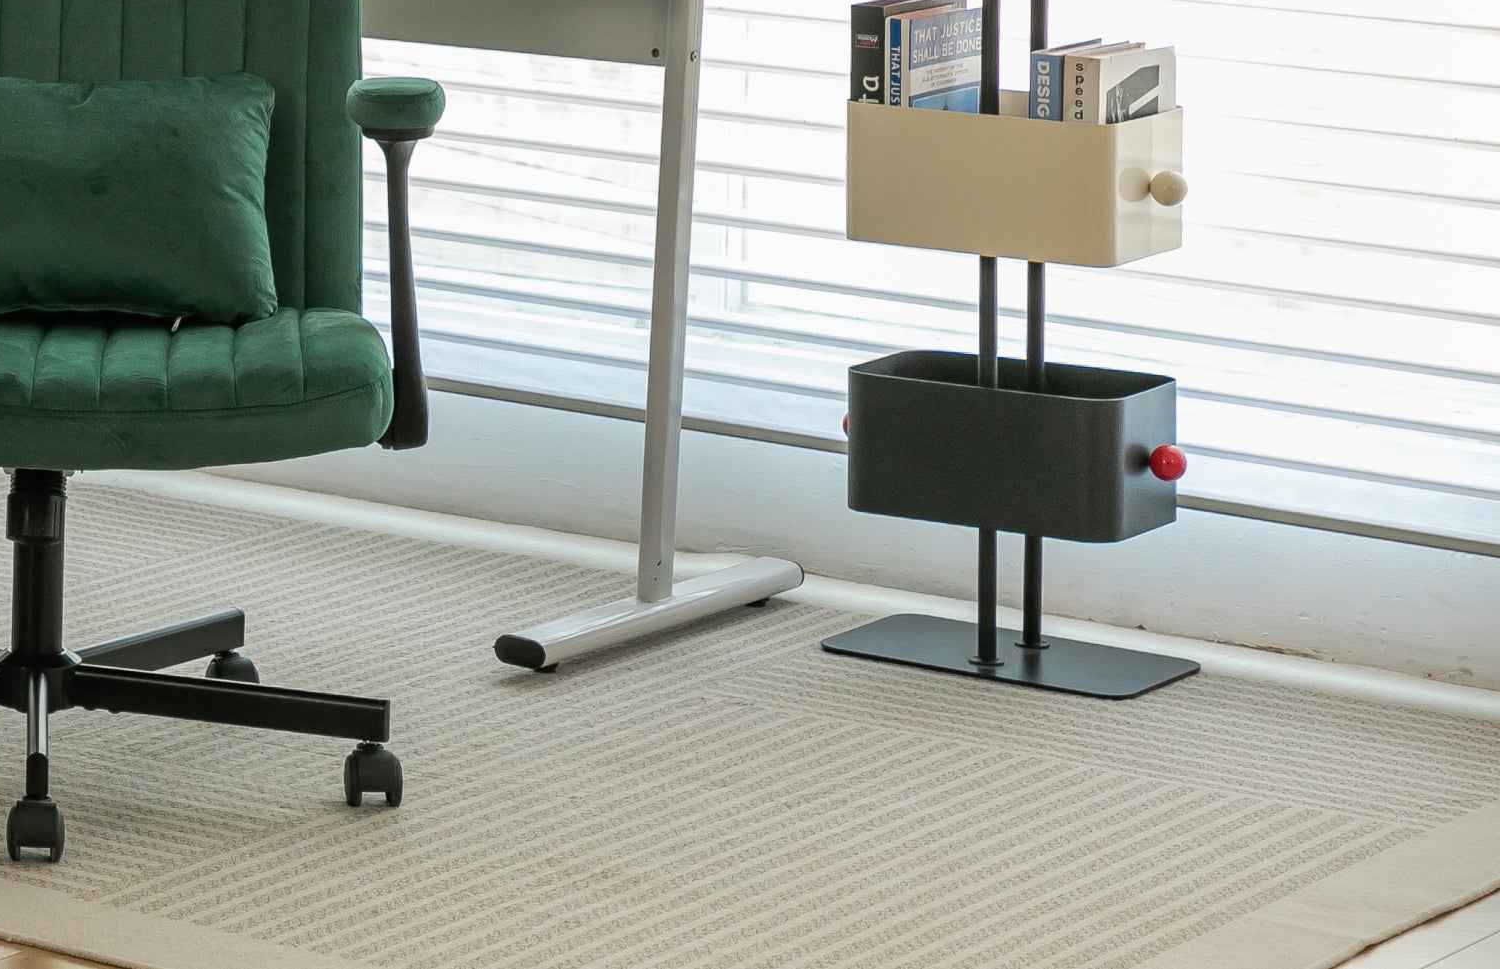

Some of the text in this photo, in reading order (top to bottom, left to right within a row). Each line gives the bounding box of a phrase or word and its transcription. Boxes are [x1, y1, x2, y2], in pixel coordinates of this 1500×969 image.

[914, 17, 981, 43] THAT JUSTICE
[890, 45, 901, 78] THAT
[913, 36, 981, 64] SHALL BE DONE
[1075, 63, 1085, 120] speed
